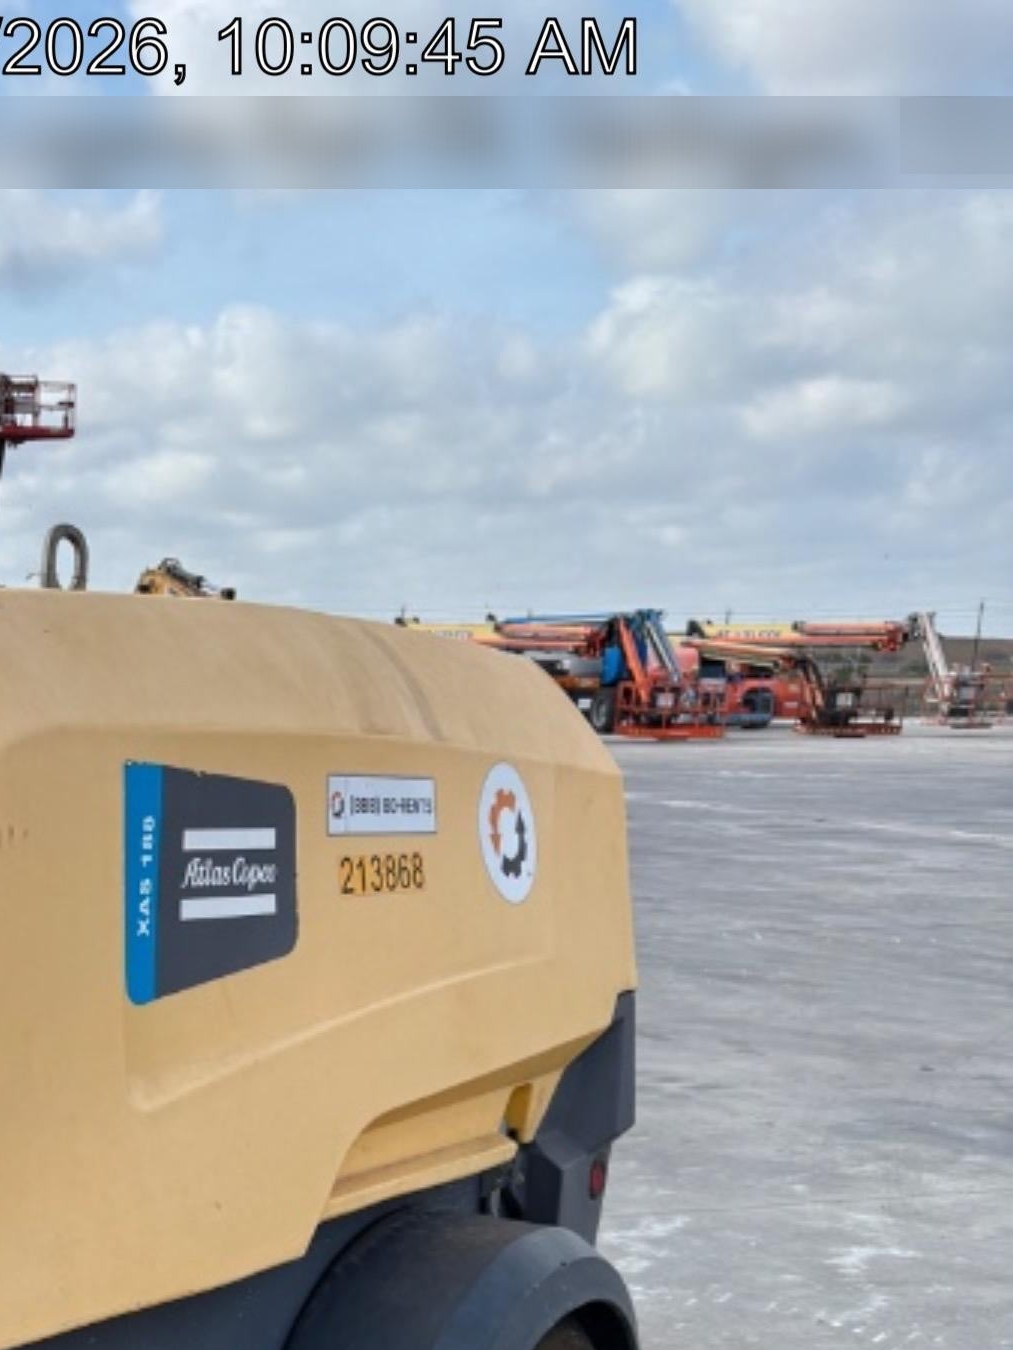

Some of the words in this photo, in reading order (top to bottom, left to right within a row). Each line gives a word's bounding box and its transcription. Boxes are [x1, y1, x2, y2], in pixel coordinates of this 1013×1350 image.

[180, 857, 231, 889] Atlas
[232, 856, 277, 892] Copco
[340, 851, 426, 895] 213868
[137, 878, 153, 937] XAS
